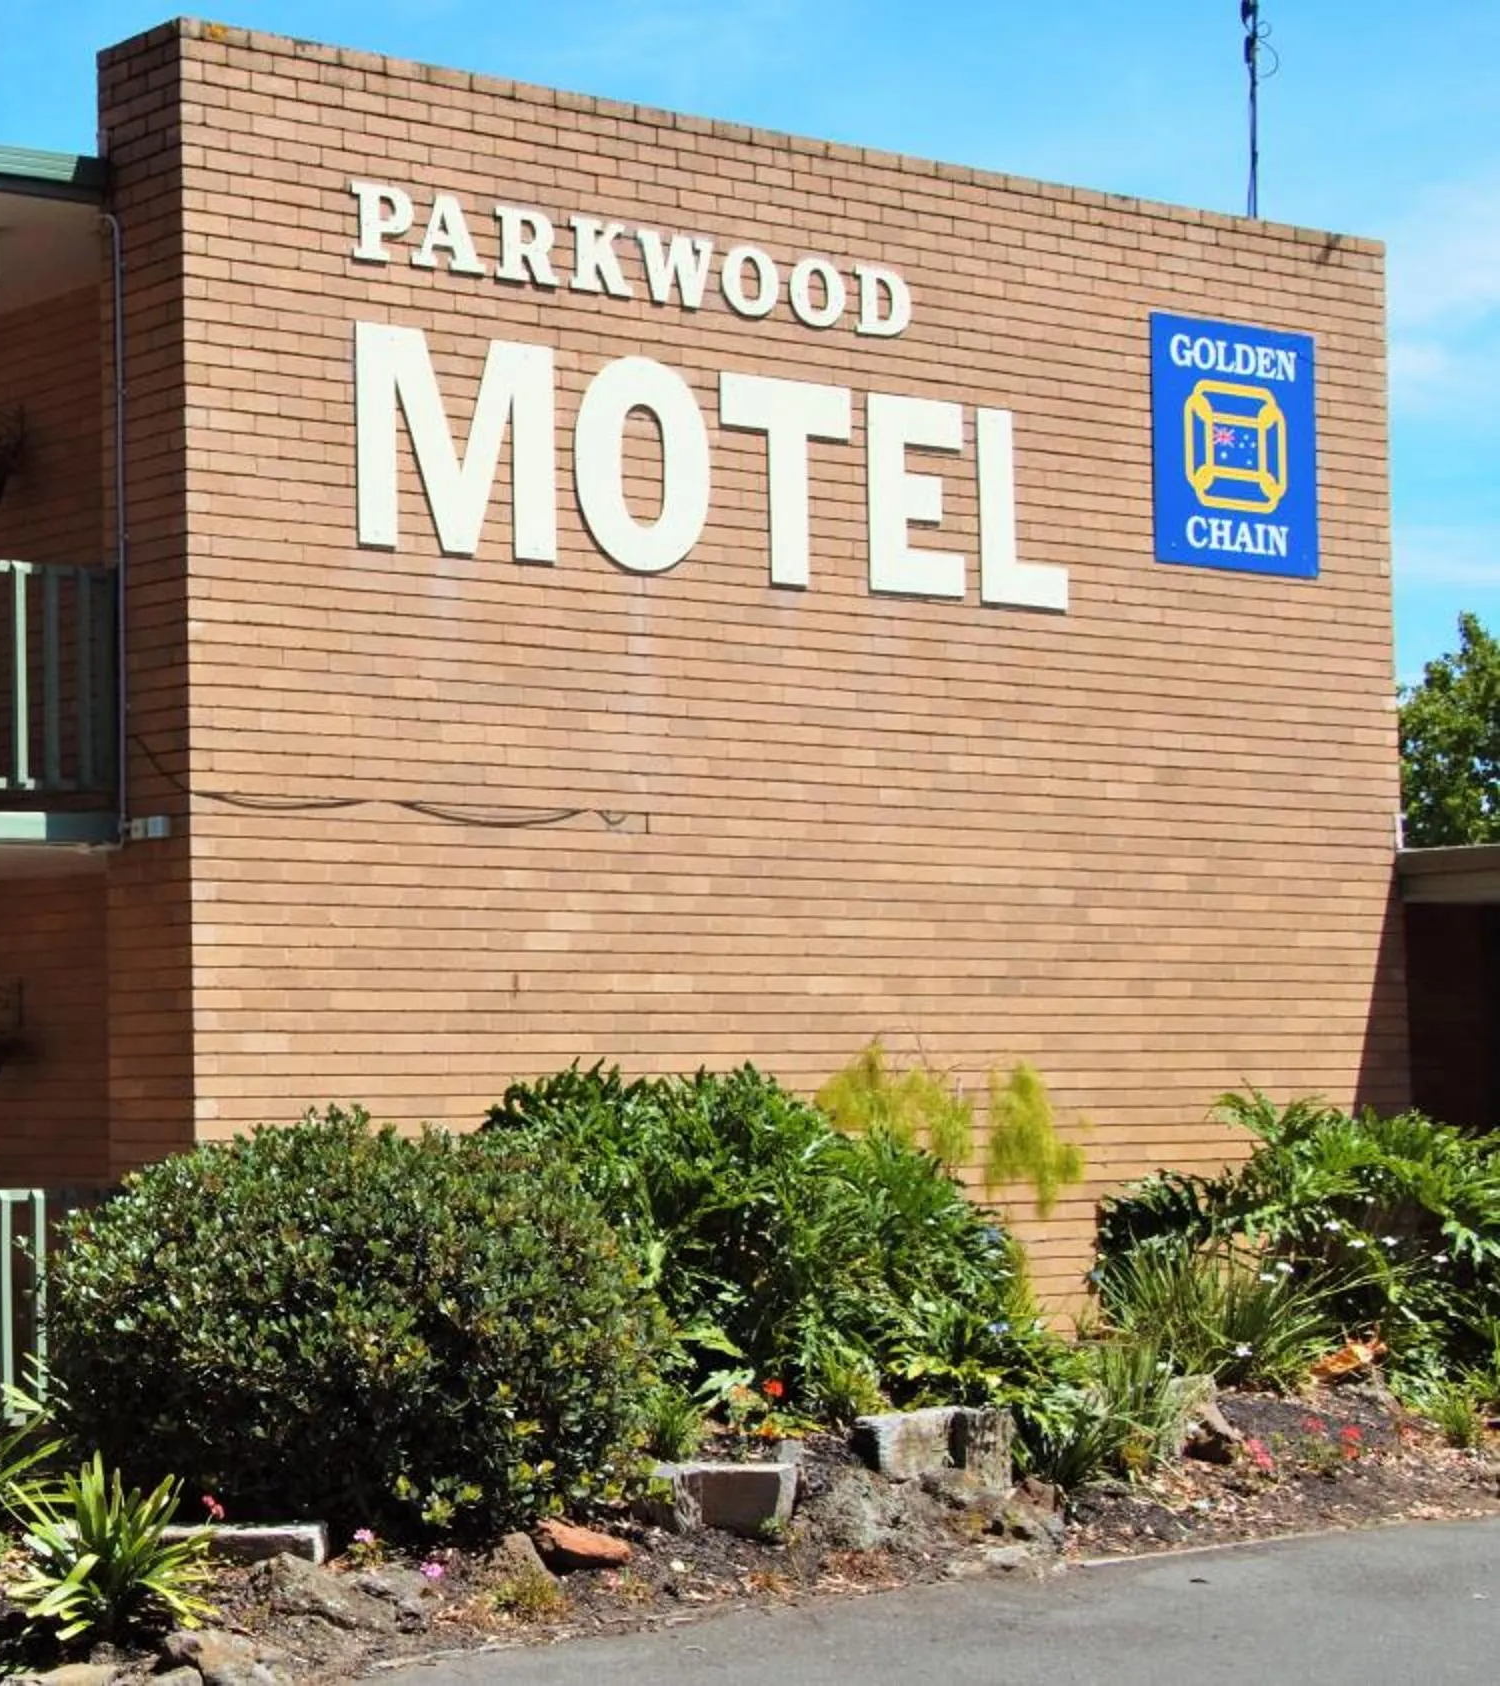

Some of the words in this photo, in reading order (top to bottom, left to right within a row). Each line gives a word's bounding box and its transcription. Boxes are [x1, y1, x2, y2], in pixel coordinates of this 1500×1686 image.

[349, 180, 912, 337] PARKWOOD
[1170, 333, 1297, 382] GOLDEN
[354, 320, 1068, 612] MOTEL
[1186, 515, 1289, 557] CHAIN
